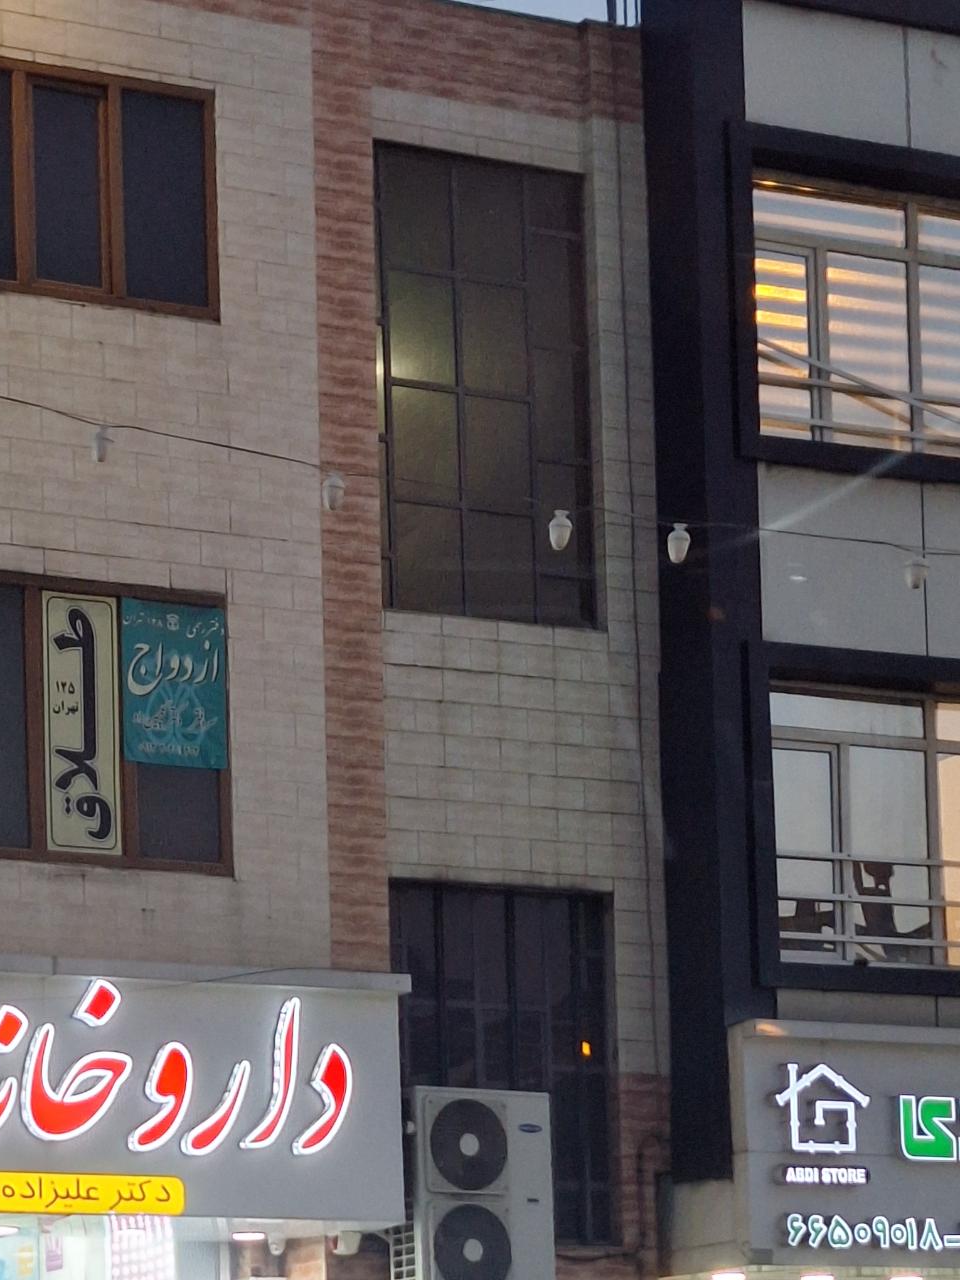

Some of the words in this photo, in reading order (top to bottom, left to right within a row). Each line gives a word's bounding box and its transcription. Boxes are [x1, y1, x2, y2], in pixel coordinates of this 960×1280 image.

[126, 639, 220, 696] ازدواج
[52, 699, 79, 716] تهران
[786, 1166, 820, 1185] ABDI
[821, 1167, 867, 1185] STORE
[1, 1176, 100, 1209] علیزاده
[109, 1180, 171, 1211] دکتر
